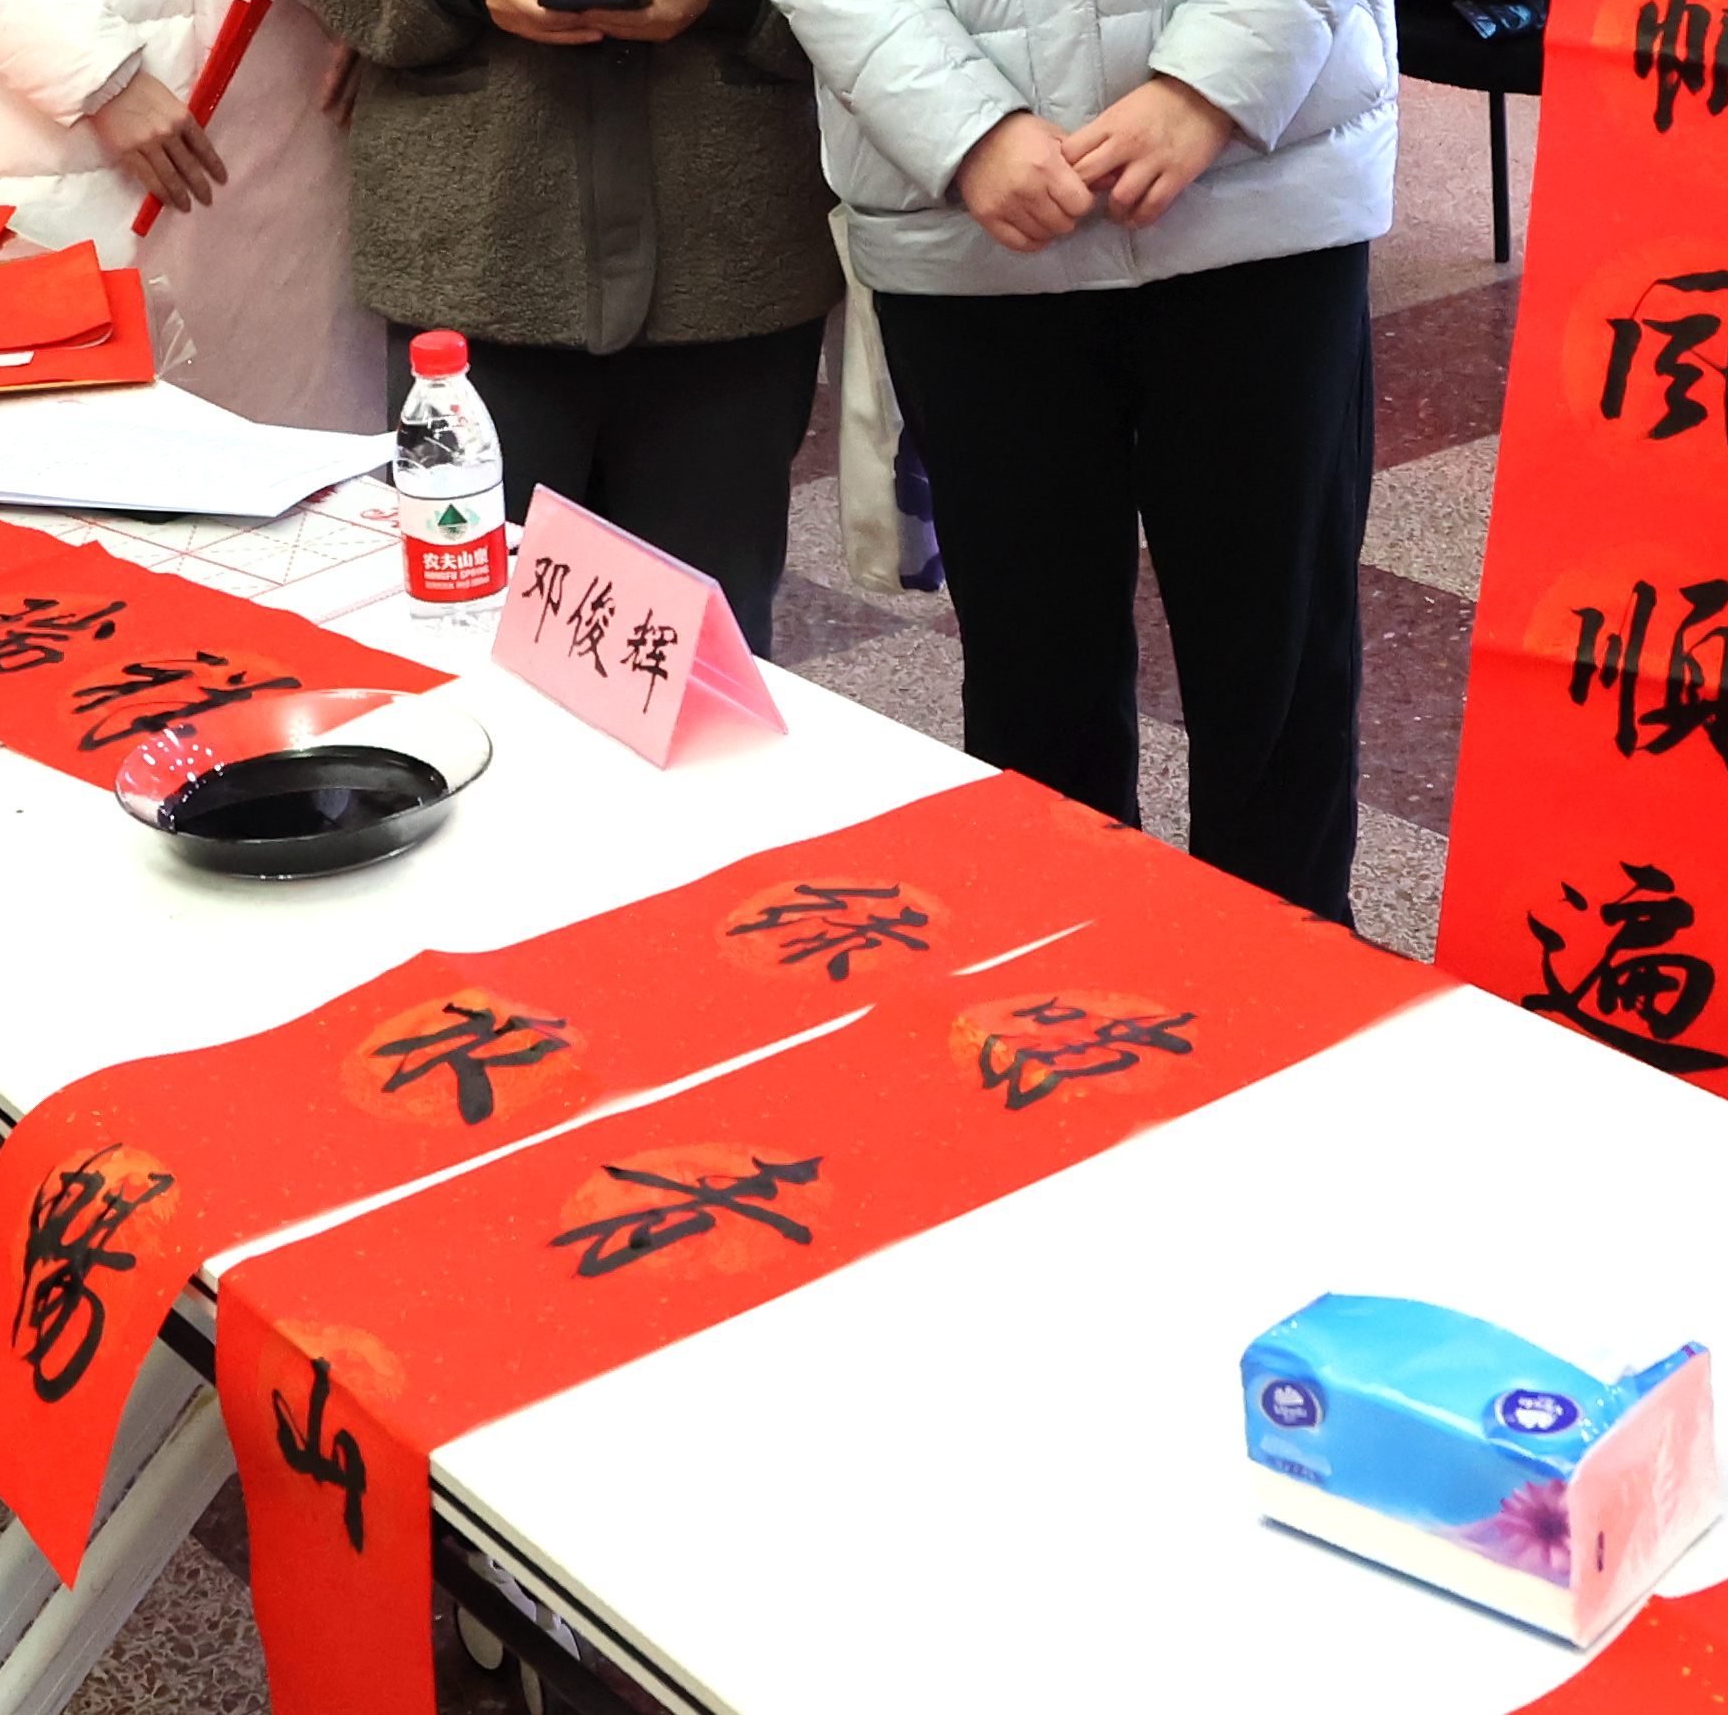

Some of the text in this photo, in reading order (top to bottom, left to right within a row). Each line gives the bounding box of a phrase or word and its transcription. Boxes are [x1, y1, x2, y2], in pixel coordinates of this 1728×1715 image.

[422, 546, 489, 571] 农夫山泉
[521, 557, 679, 714] 邓俊辉
